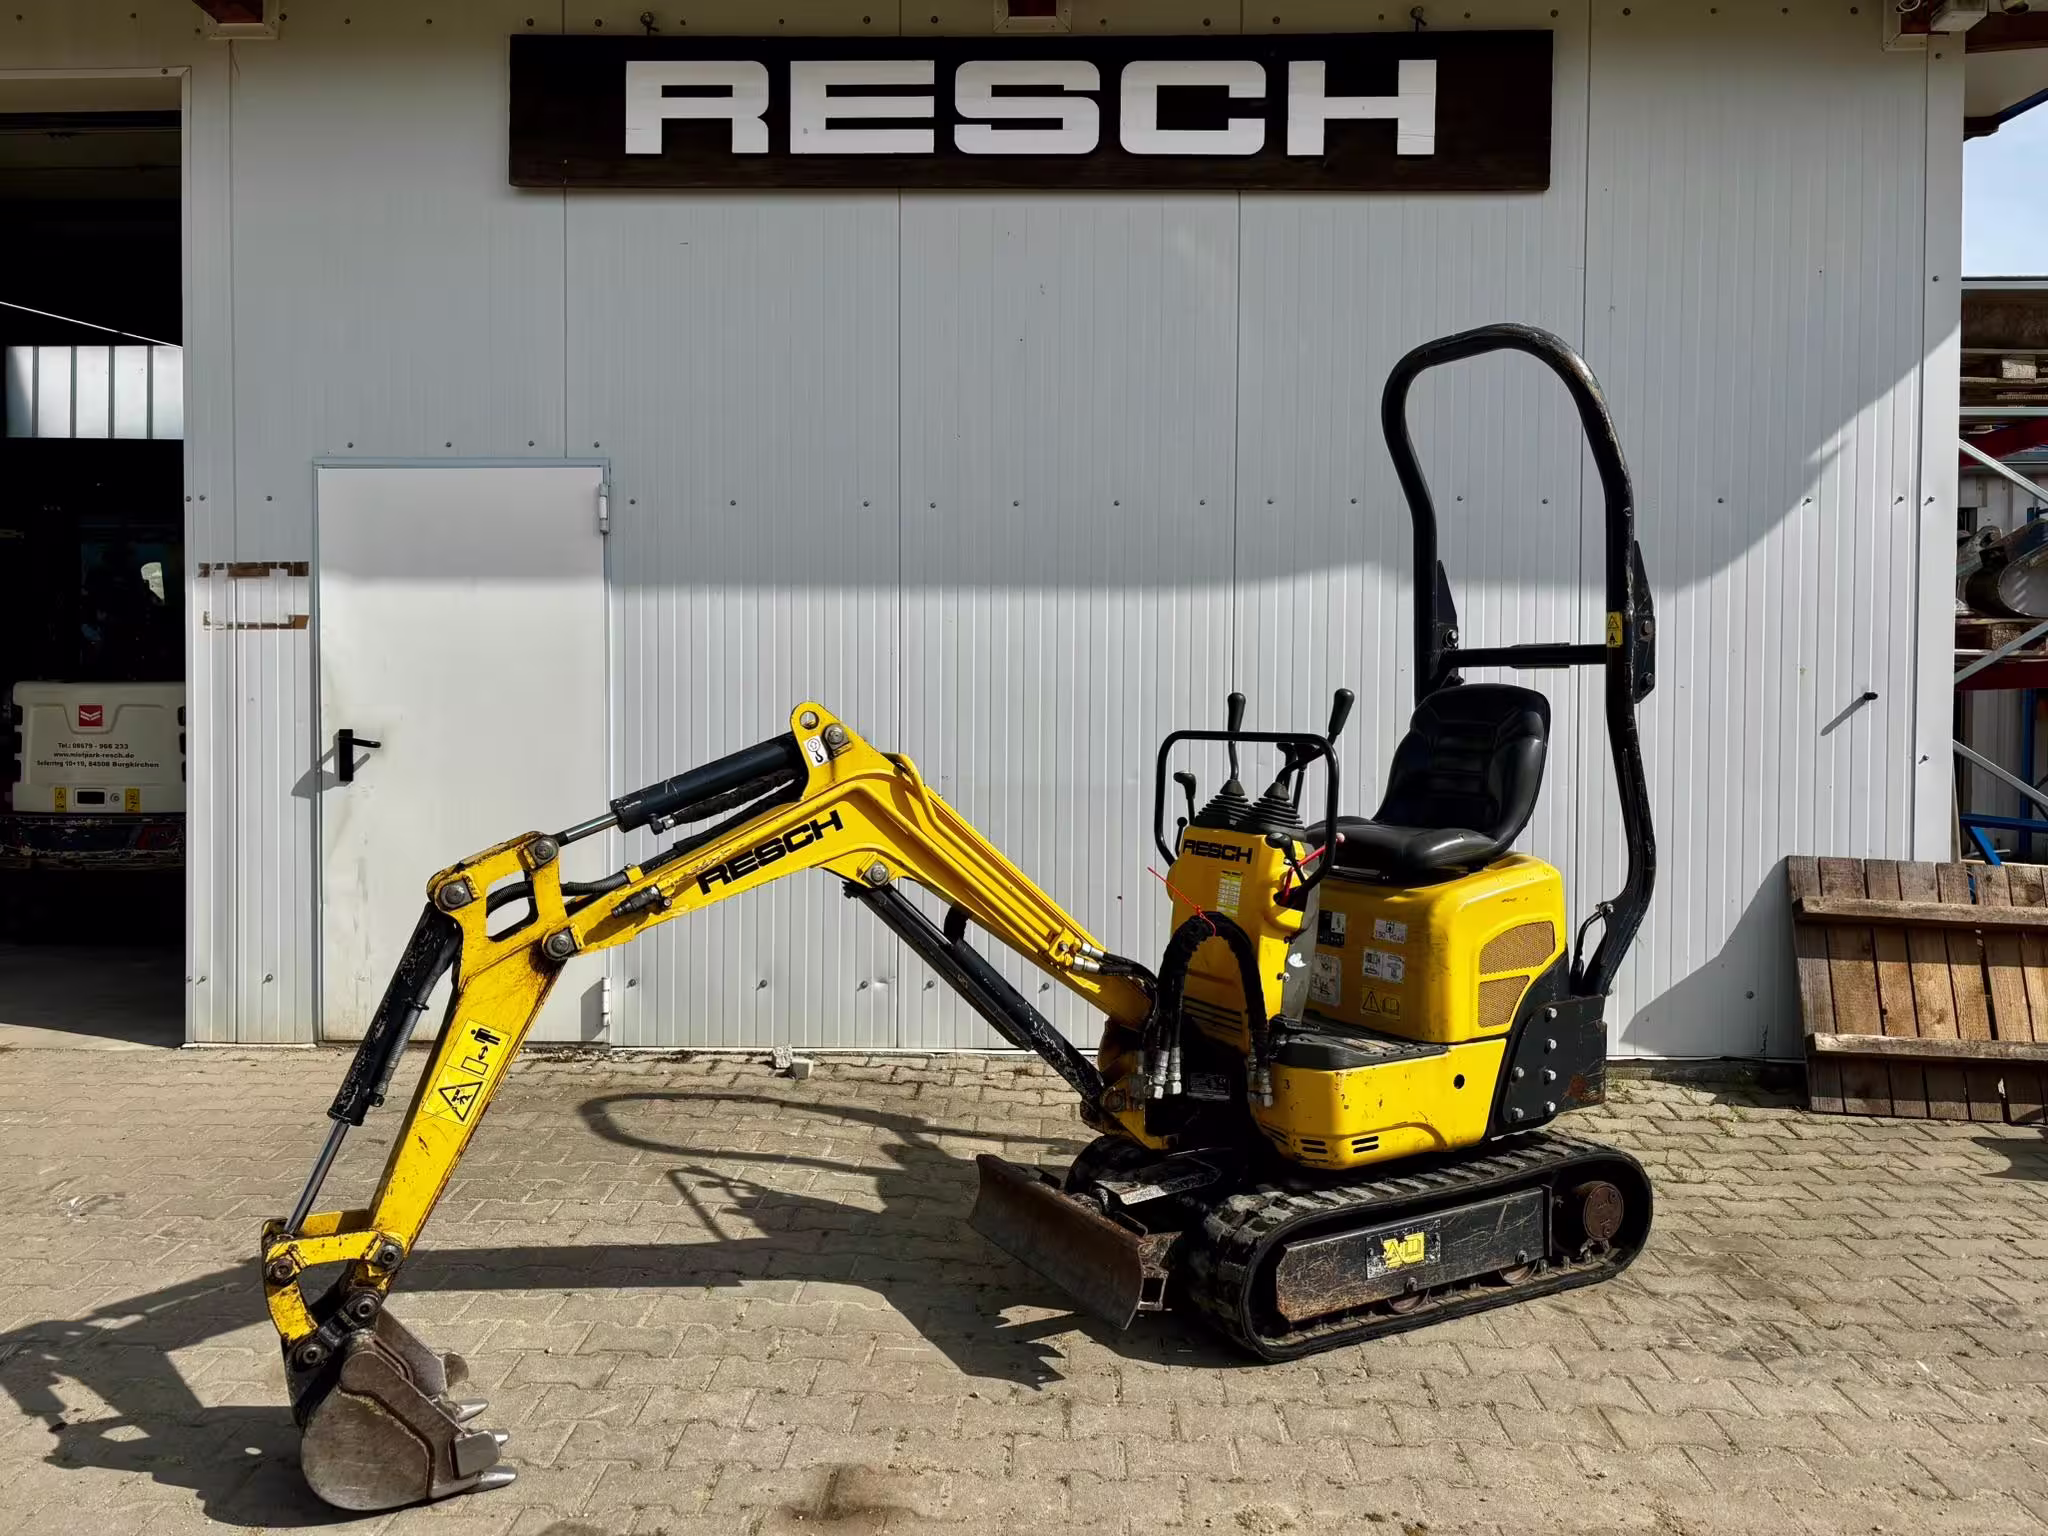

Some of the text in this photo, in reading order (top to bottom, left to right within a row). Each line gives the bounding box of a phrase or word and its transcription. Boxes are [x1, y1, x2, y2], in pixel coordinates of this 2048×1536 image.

[625, 59, 1437, 156] RESCH
[112, 761, 160, 769] Burgkirchen
[695, 809, 844, 896] RESCH
[1182, 839, 1253, 864] RESCH
